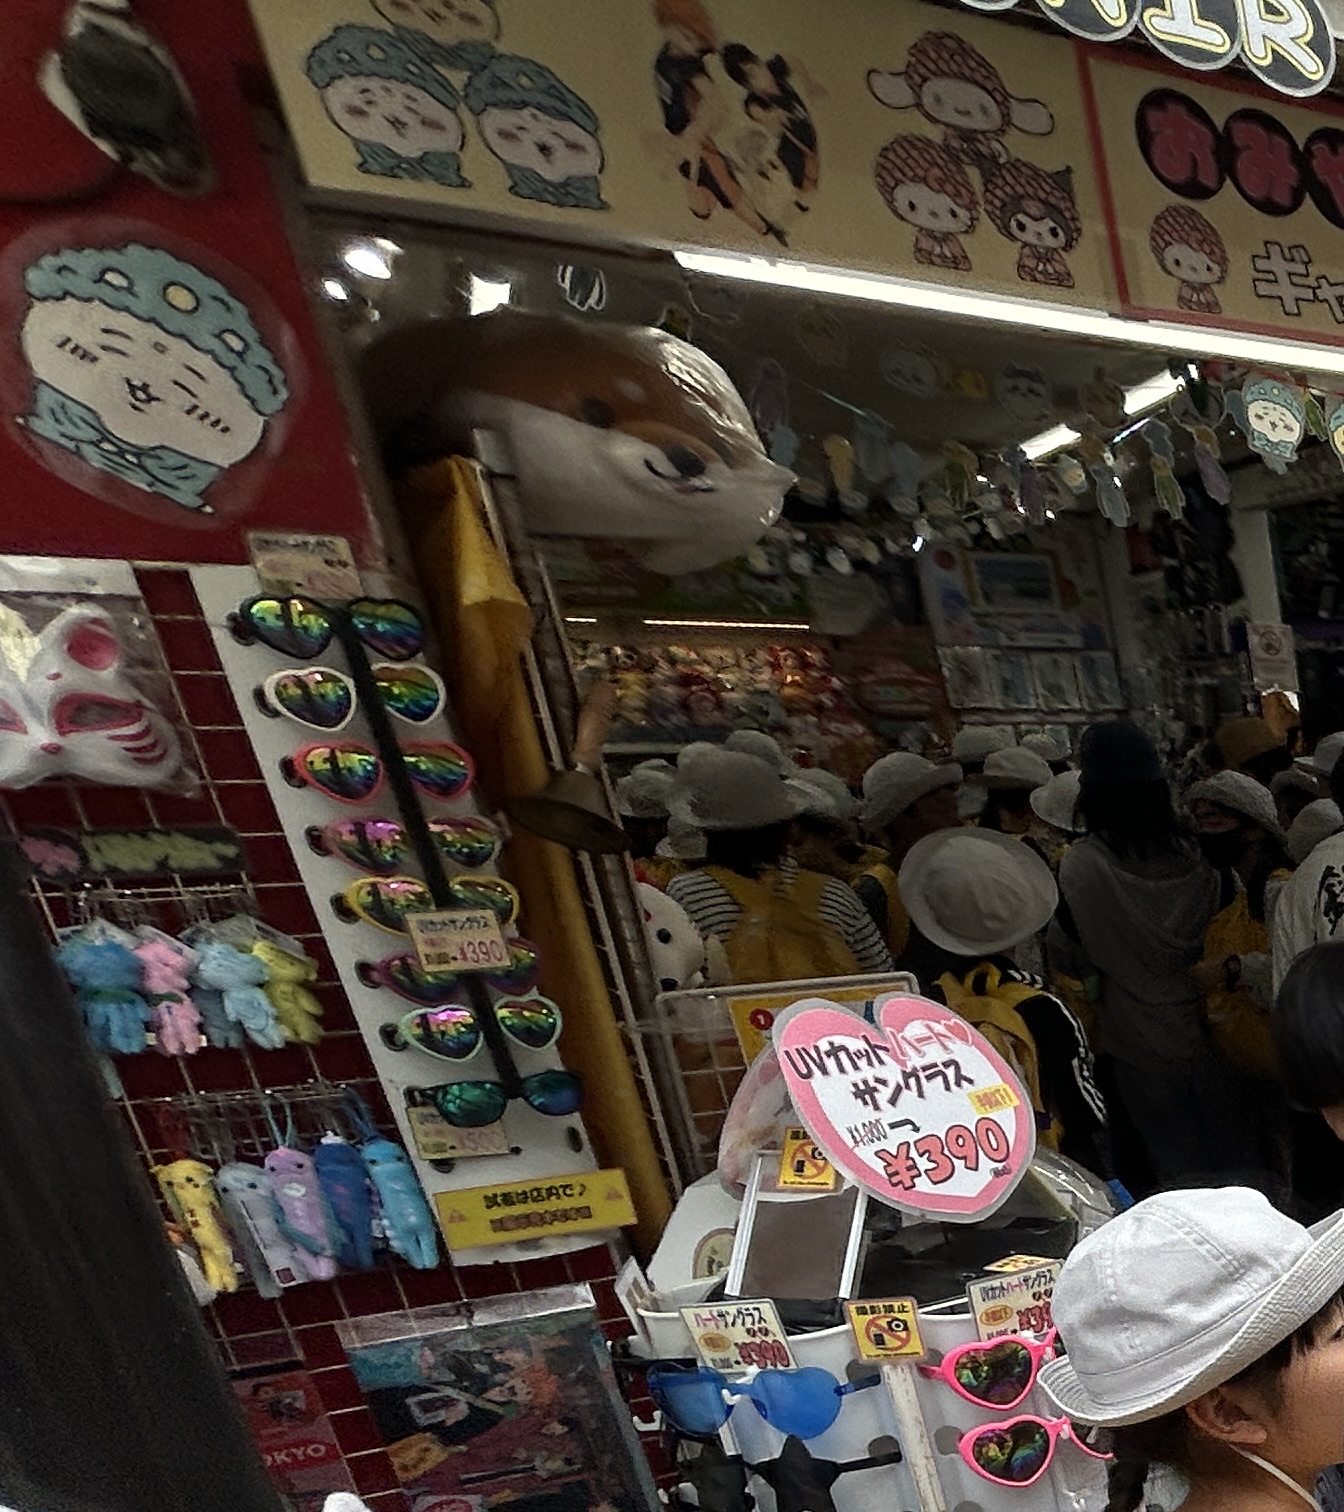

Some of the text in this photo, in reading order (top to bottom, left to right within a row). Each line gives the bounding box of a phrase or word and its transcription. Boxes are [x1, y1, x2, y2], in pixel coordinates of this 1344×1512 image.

[851, 1058, 974, 1111] サングラス
[875, 1117, 1010, 1190] ¥390
